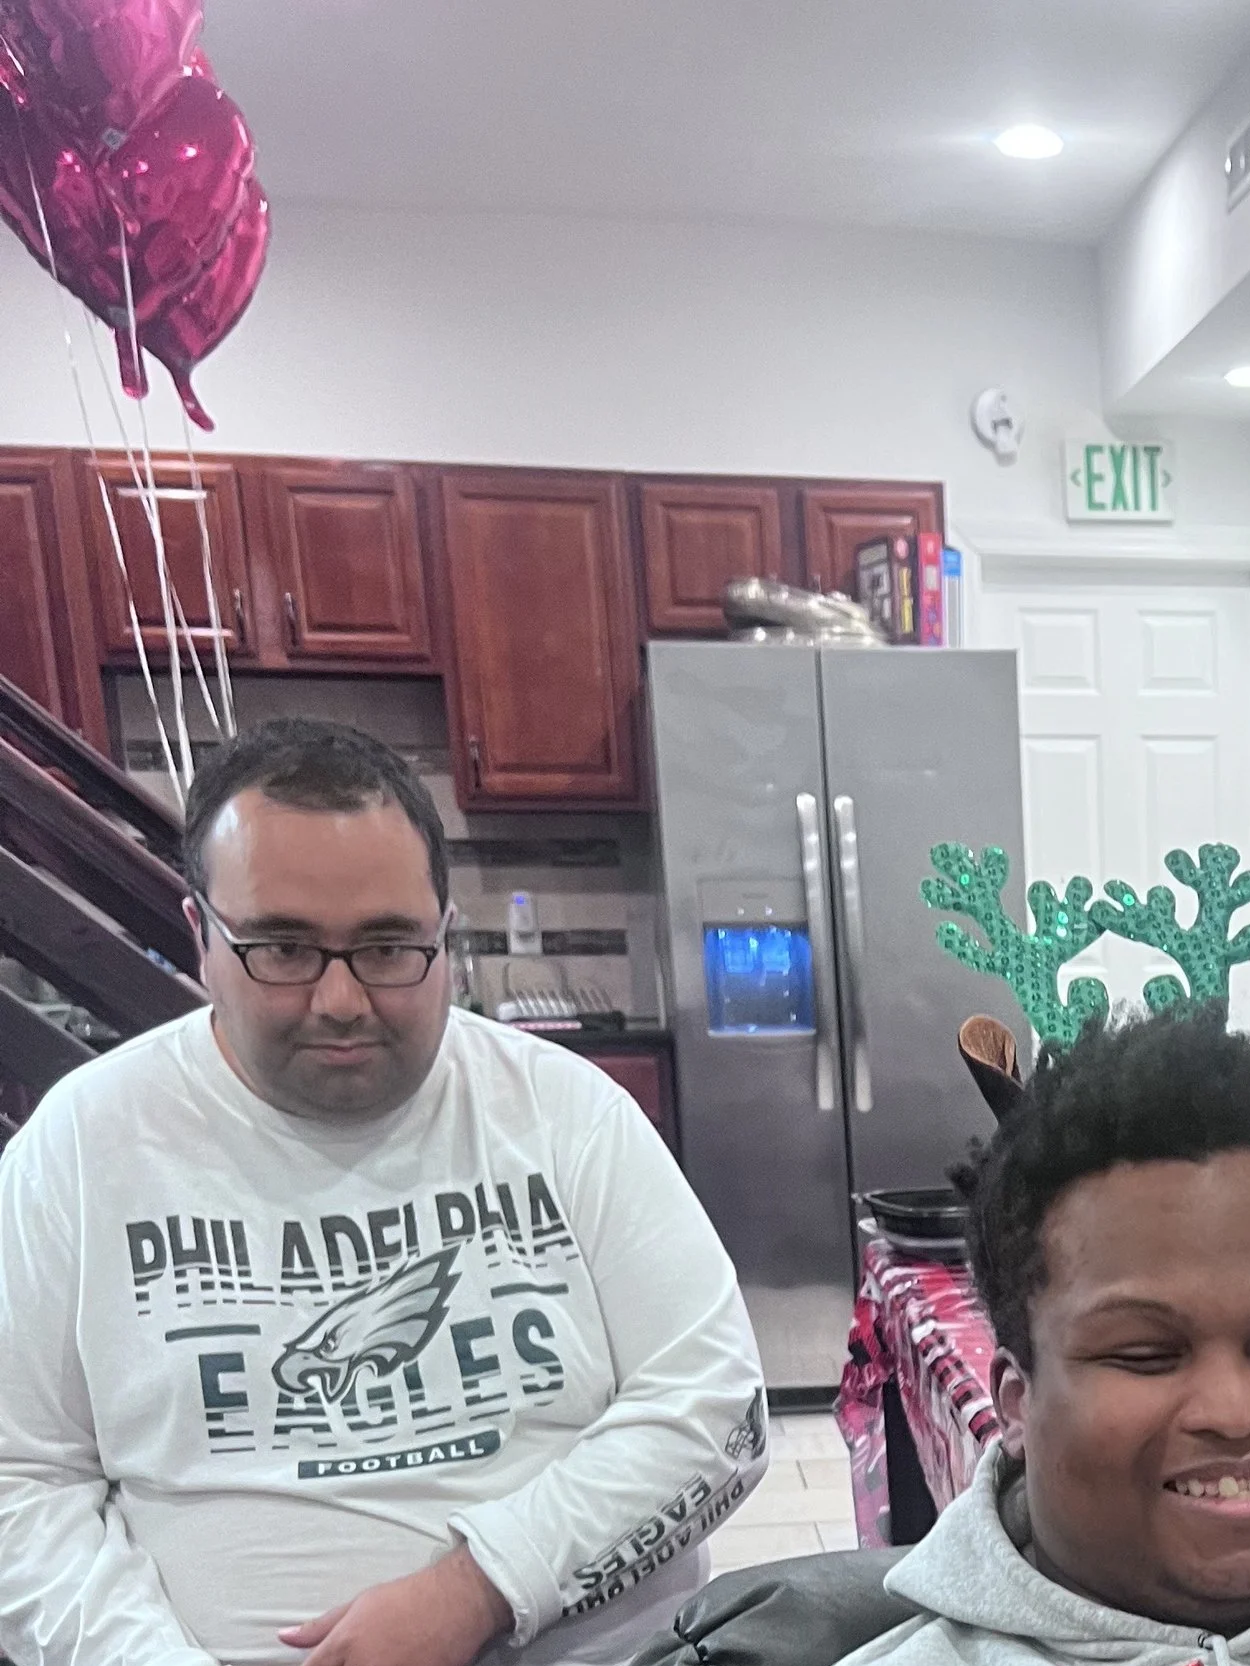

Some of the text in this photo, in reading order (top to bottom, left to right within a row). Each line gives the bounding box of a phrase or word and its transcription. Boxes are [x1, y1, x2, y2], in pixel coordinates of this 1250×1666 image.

[1084, 444, 1162, 511] EXIT
[126, 1172, 580, 1317] PHILADELPHIA
[316, 1440, 486, 1476] FOOTBALL
[573, 1472, 712, 1590] EAGLES
